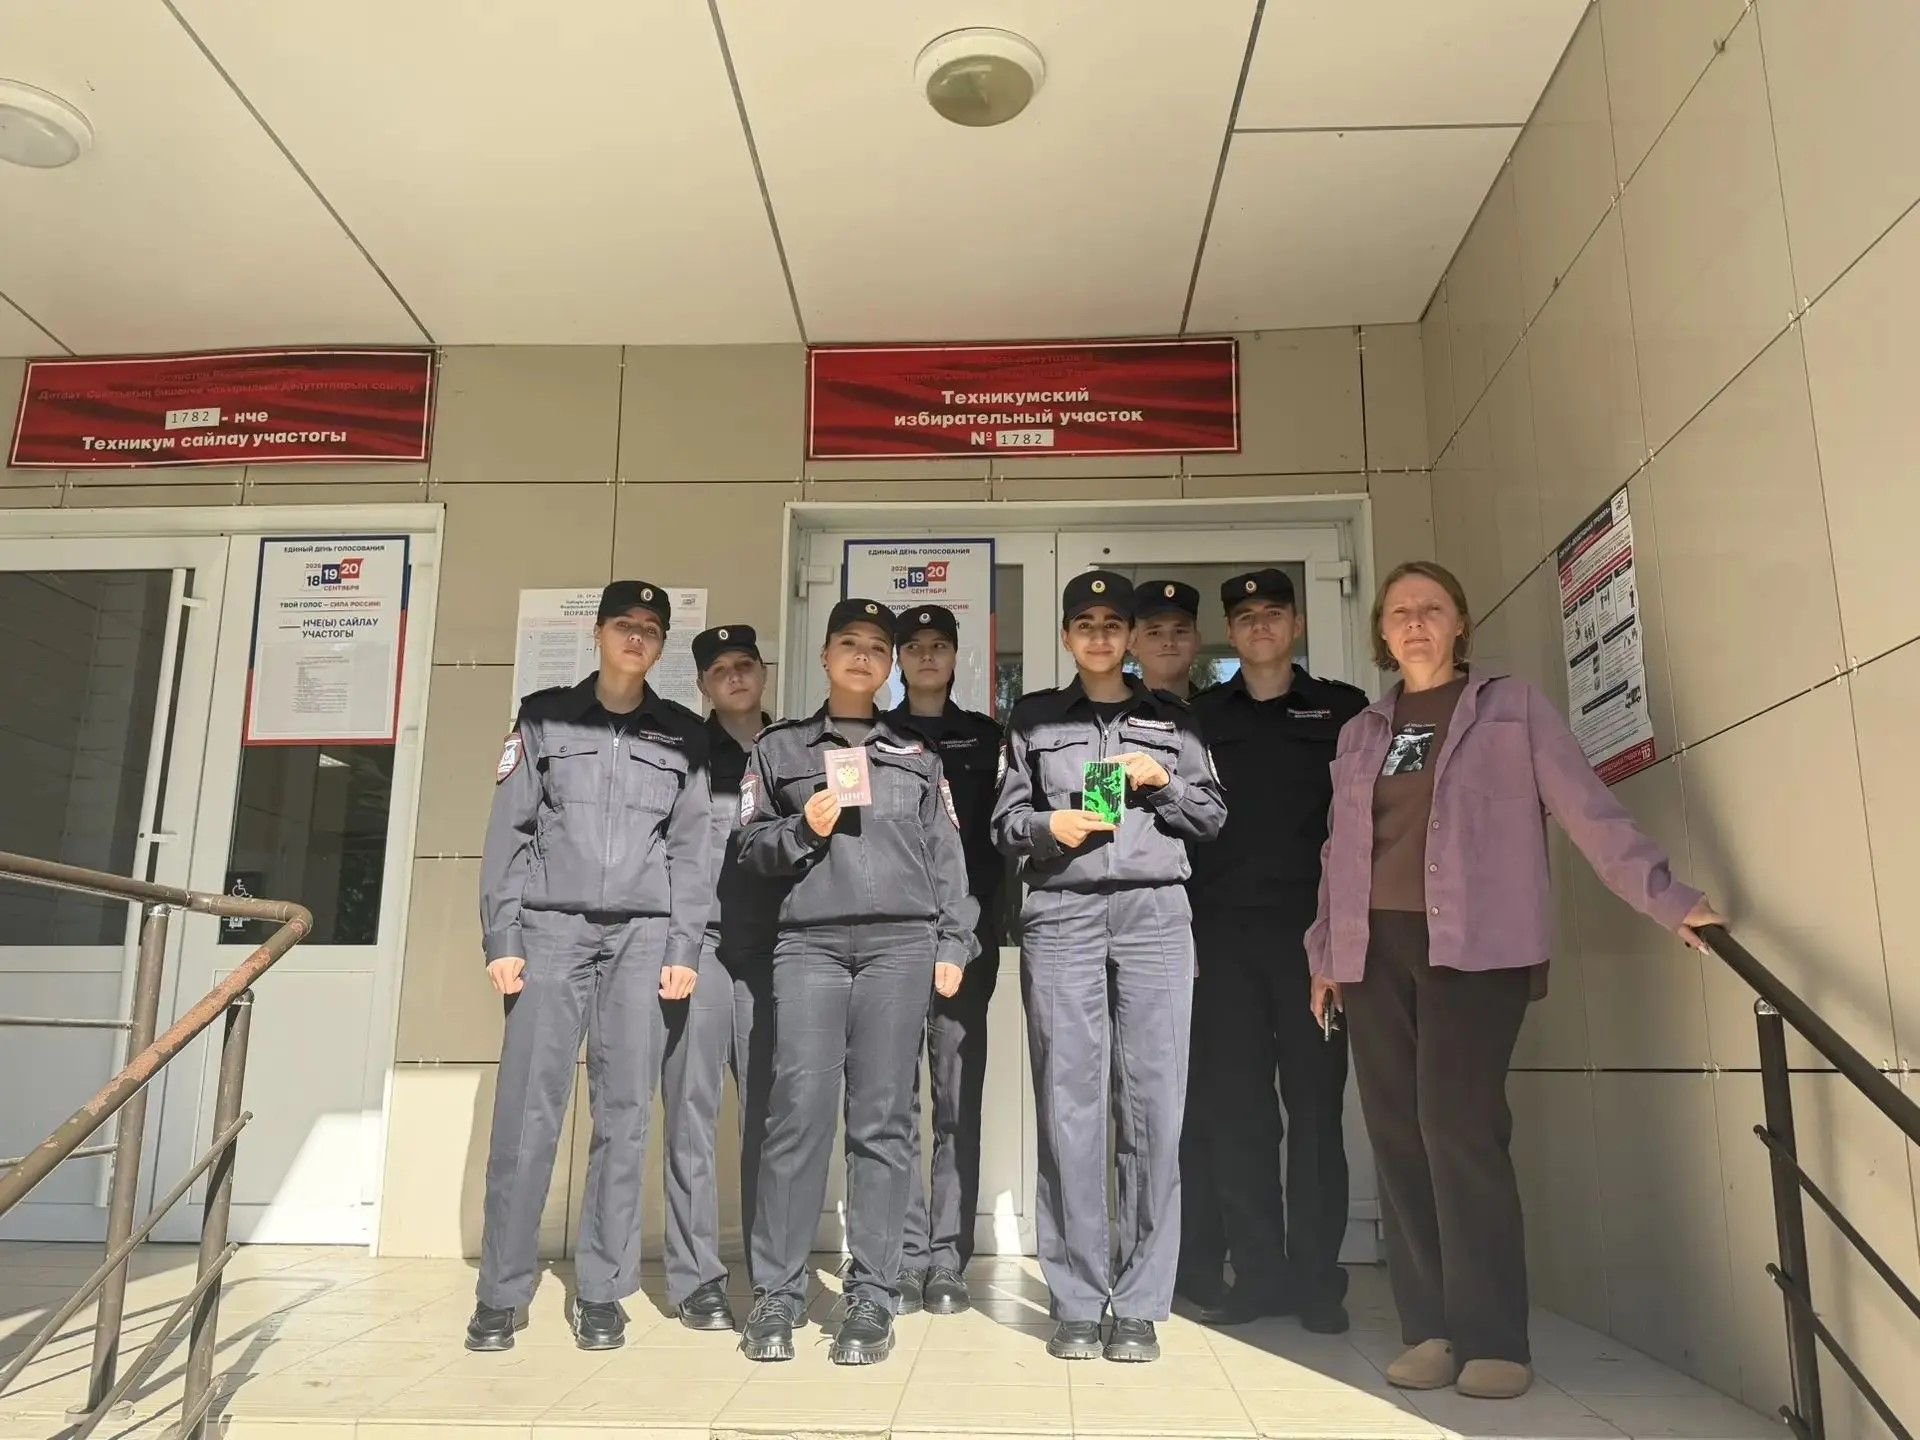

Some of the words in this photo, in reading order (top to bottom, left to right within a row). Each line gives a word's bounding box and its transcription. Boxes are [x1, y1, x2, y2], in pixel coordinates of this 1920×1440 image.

[941, 386, 1089, 405] Техникумский
[171, 410, 210, 424] 1782
[234, 410, 269, 423] нче
[894, 408, 1053, 428] избирательный
[1060, 409, 1144, 426] участок
[82, 435, 175, 451] Техникум
[180, 430, 250, 448] сайлау
[252, 430, 347, 447] участогы
[970, 431, 992, 446] №
[1001, 433, 1042, 445] 1782
[284, 545, 314, 553] ЕДИНЫЙ
[314, 545, 333, 553] ДЕНЬ
[333, 544, 385, 552] ГОЛОСОВАНИЯ
[868, 548, 898, 556] ЕДИНЫЙ
[306, 575, 320, 587] 18
[323, 568, 338, 580] 19
[341, 563, 359, 574] 20
[893, 578, 907, 589] 18
[910, 571, 925, 583] 19
[928, 565, 945, 578] 20
[303, 618, 337, 628] НЧЕ(Ы)
[339, 617, 379, 627] САЙЛАУ
[302, 629, 354, 639] УЧАСТОГЫ
